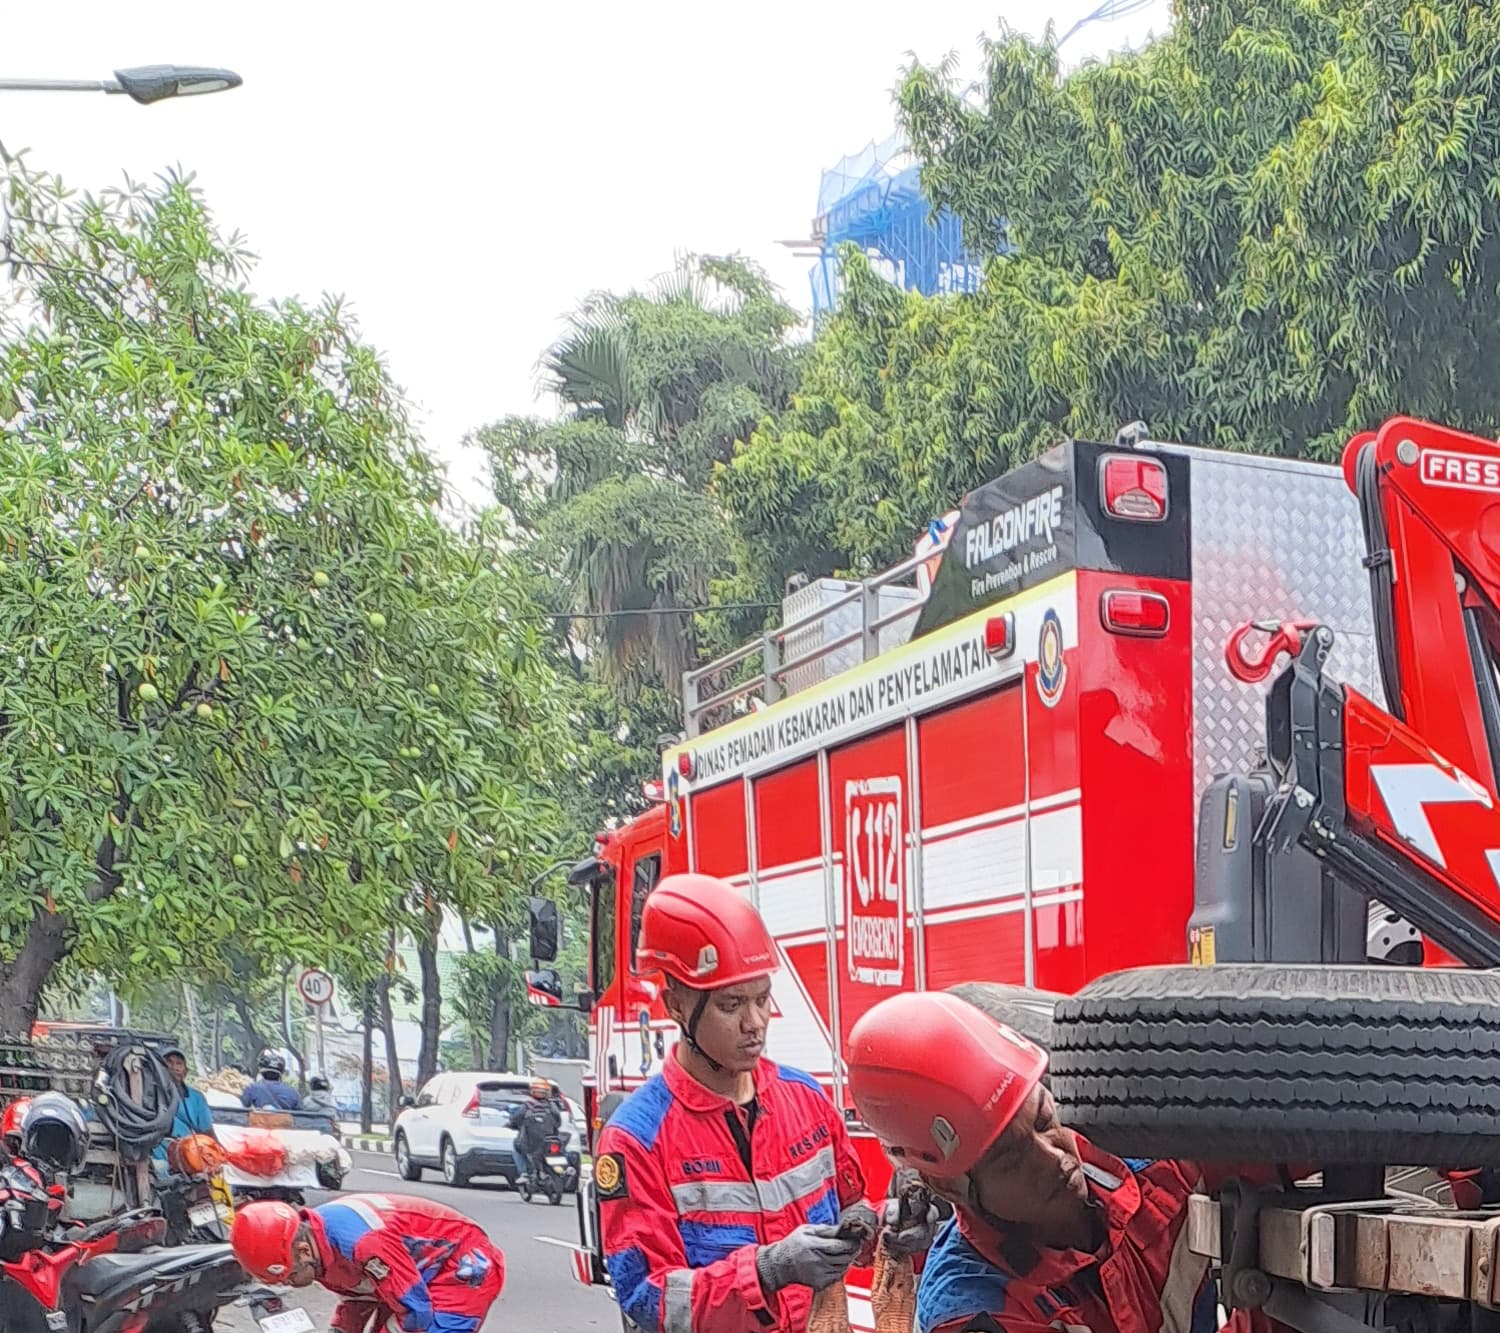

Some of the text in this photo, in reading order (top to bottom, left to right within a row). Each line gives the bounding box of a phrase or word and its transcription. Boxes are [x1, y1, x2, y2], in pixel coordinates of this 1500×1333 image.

[965, 485, 1063, 569] FALCONFIRE
[697, 634, 992, 780] DINAS PEMADAM KEBAKARAN DAN PENYELAMATAN
[865, 802, 898, 901] 112
[852, 915, 899, 960] EMERGENCY
[305, 976, 321, 995] 40
